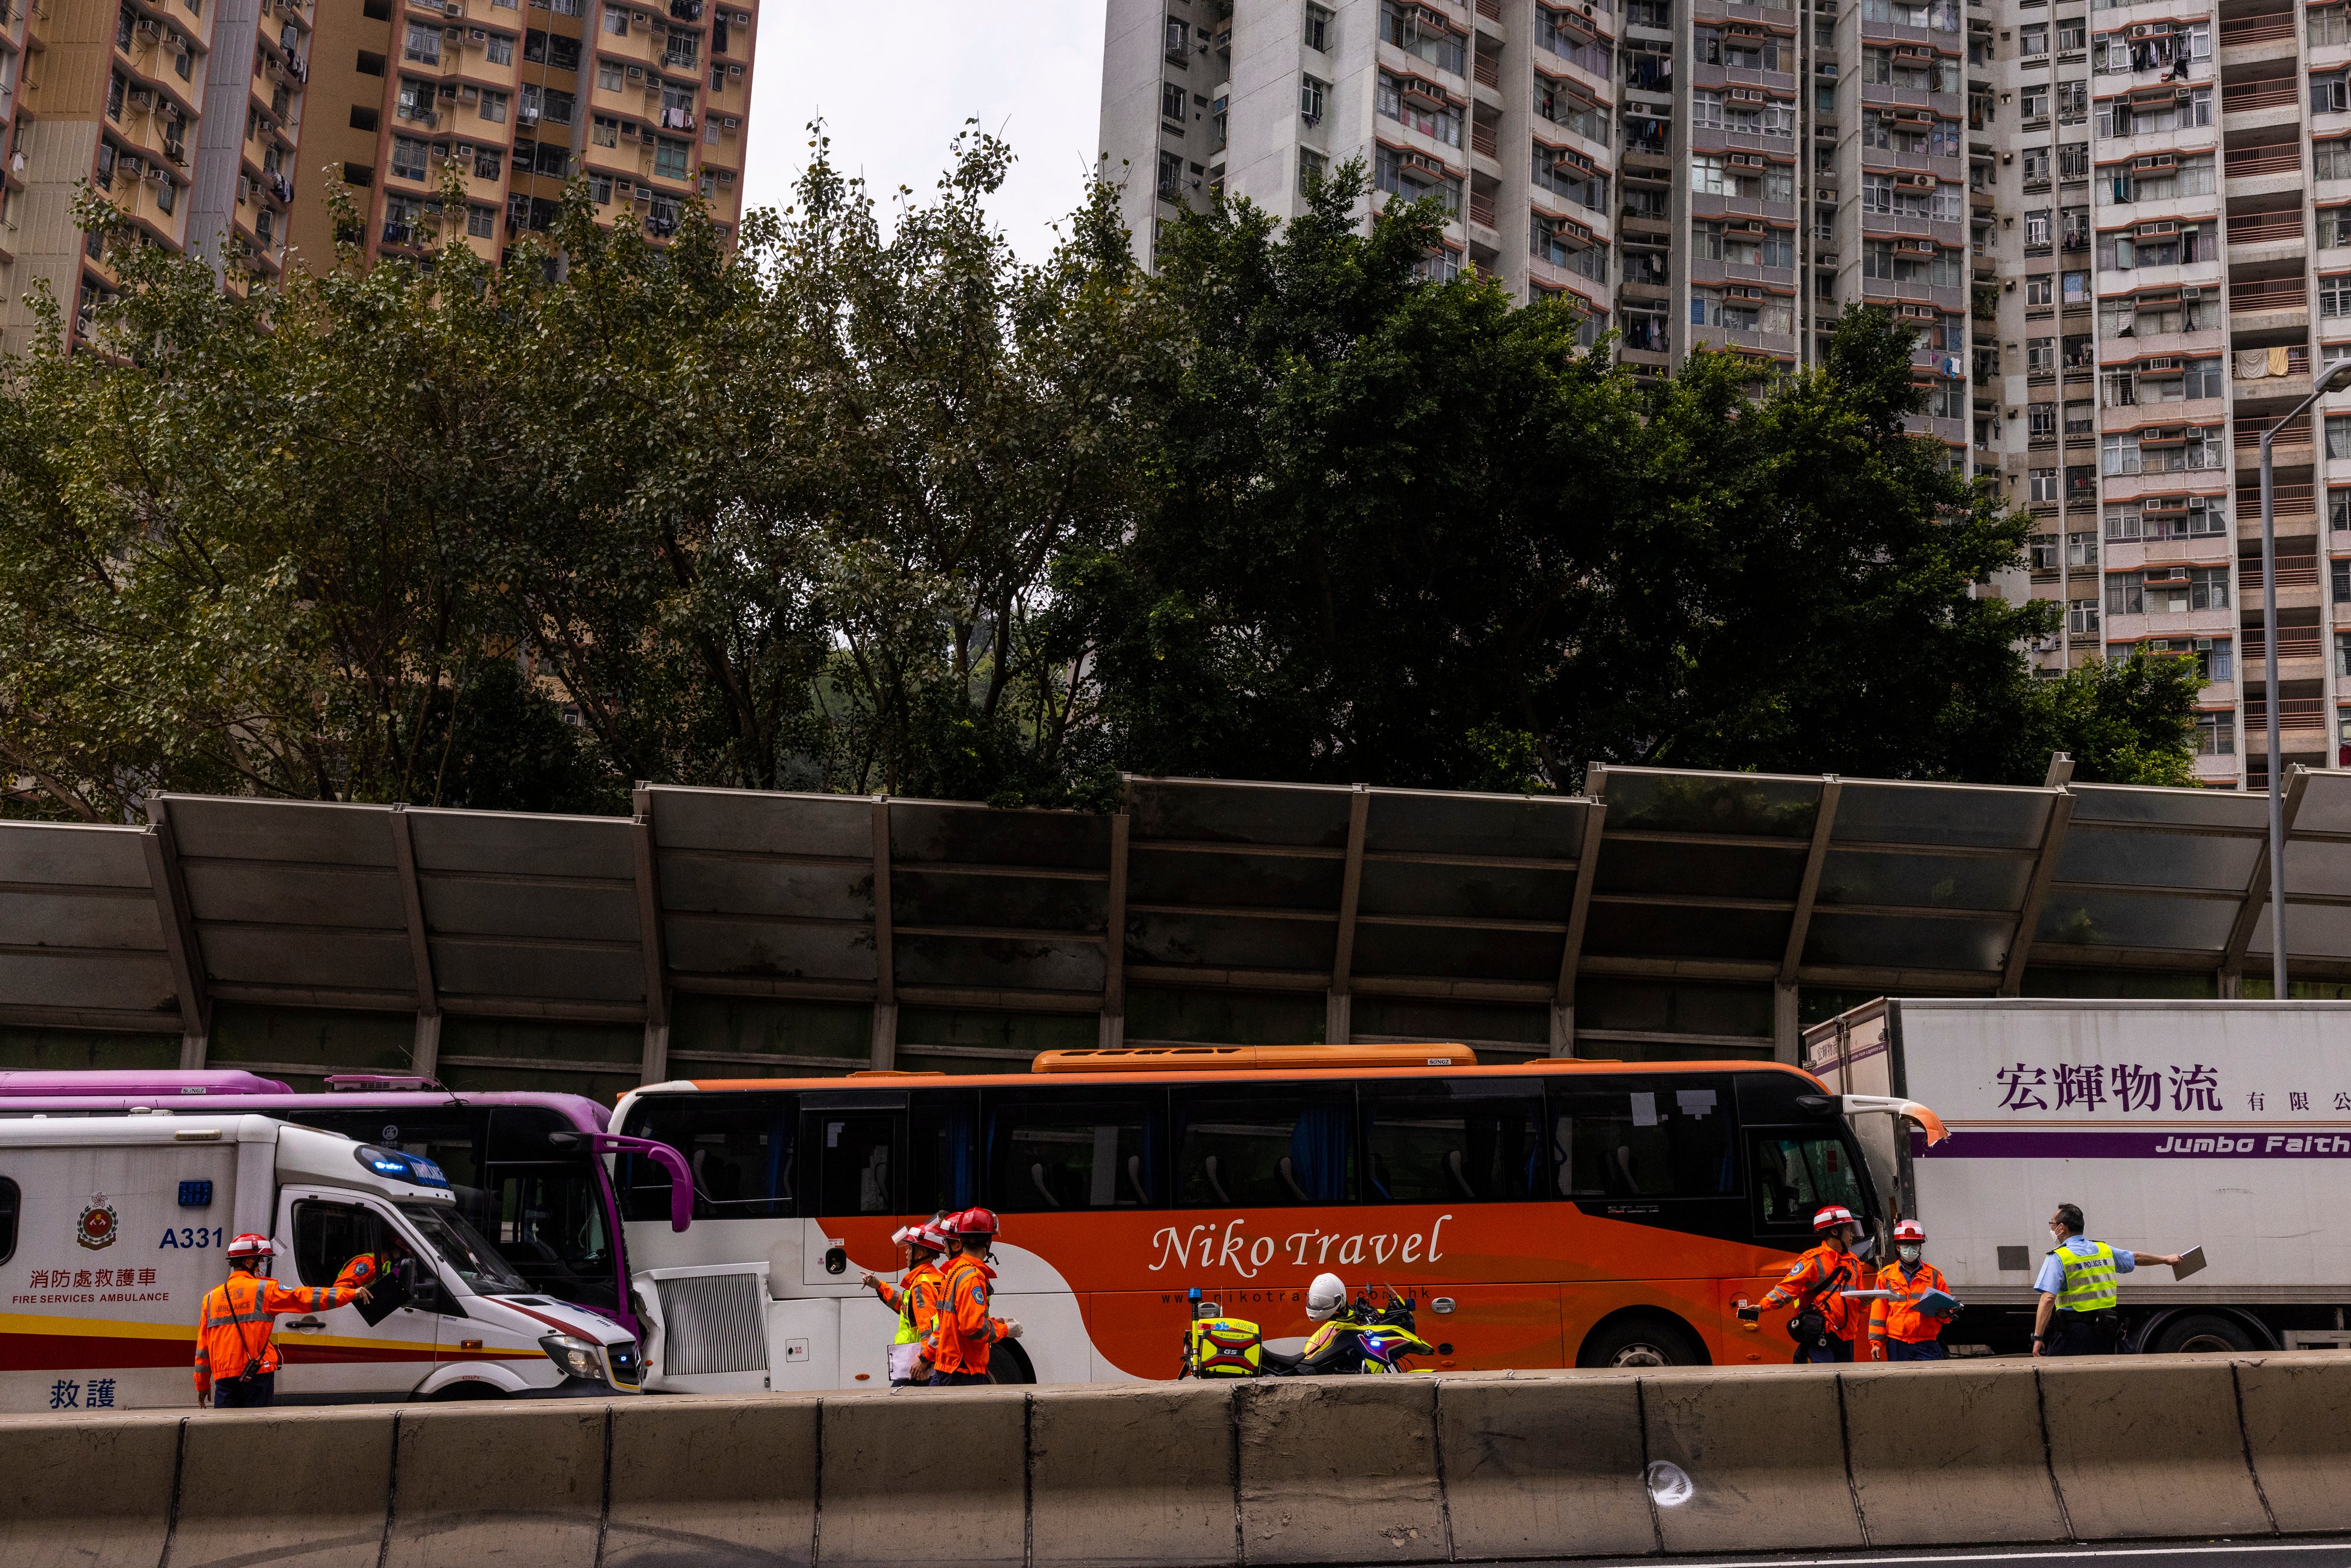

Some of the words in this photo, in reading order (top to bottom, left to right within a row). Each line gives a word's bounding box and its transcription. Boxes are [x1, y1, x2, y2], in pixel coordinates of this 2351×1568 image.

[1997, 1063, 2223, 1113] 宏輝物流
[2155, 1136, 2255, 1153] Jumbo
[2265, 1135, 2350, 1152] Faith
[159, 1227, 223, 1249] A331
[1148, 1218, 1275, 1278] Niko
[1285, 1214, 1452, 1265] Travel
[2084, 1259, 2102, 1268] POLICE
[29, 1267, 156, 1289] 消防處救護車
[12, 1295, 37, 1304] FIRE
[40, 1294, 95, 1303] SERVICES
[100, 1292, 169, 1302] AMBULANCE
[49, 1378, 116, 1409] 救護
